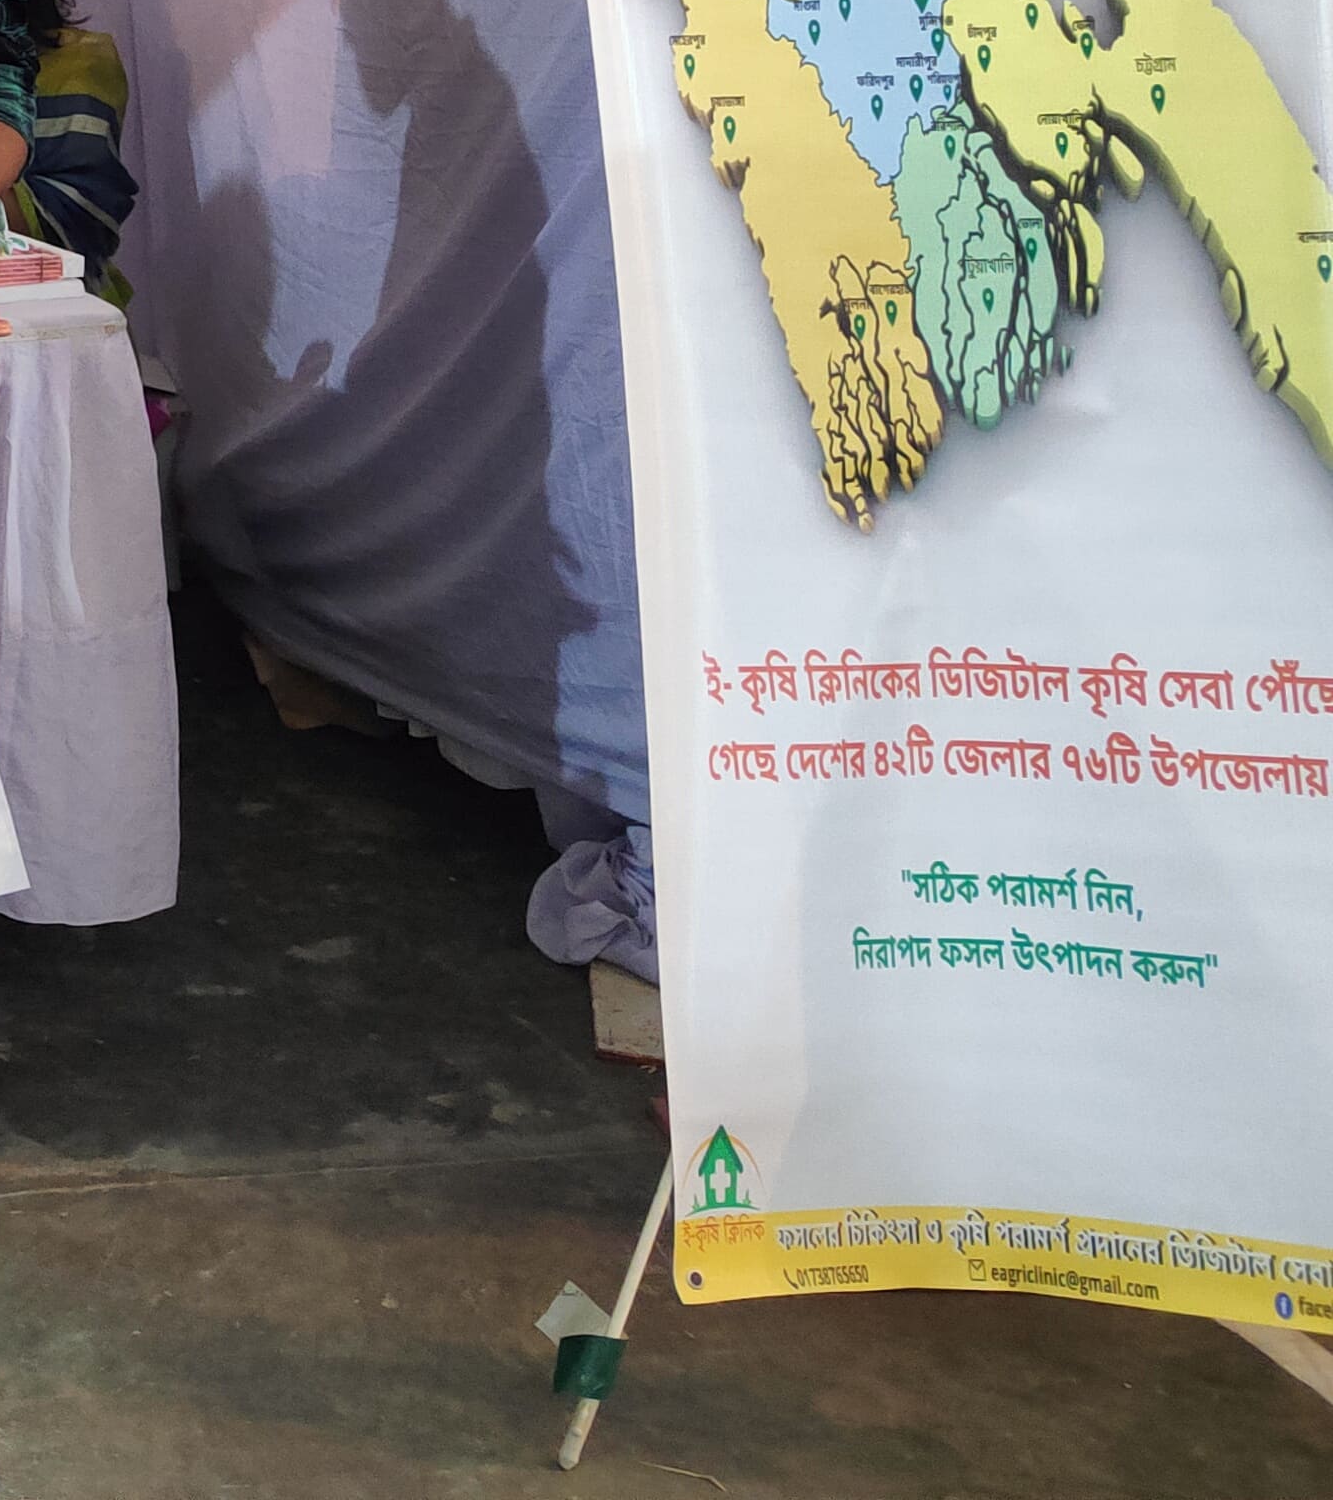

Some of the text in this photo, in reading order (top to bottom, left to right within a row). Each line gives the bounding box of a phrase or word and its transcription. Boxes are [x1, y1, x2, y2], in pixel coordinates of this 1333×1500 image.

[738, 650, 798, 716] কৃষি
[804, 649, 922, 704] ক্লিনিকের
[928, 646, 1070, 704] ডিজিটাল
[1077, 652, 1148, 719] কৃষি
[1158, 669, 1235, 711] সেবা
[707, 741, 780, 784] গেছে
[786, 739, 866, 782] দেশের
[873, 725, 935, 779] ৪২টি
[943, 737, 1051, 782] জেলার
[1062, 731, 1142, 787] ৭৬টি
[986, 867, 1078, 911] পরামর্শ
[1084, 868, 1144, 922] নিন,
[852, 927, 933, 972] নিরাপদ
[938, 935, 1006, 971] ফসল
[1011, 928, 1123, 980] উৎপাদন
[682, 1213, 766, 1251] ই-কৃষি ক্লিনিক
[947, 1207, 991, 1256] কৃষি
[990, 1263, 1161, 1301] eagriclinic@gmail.com
[1298, 1296, 1333, 1318] face
